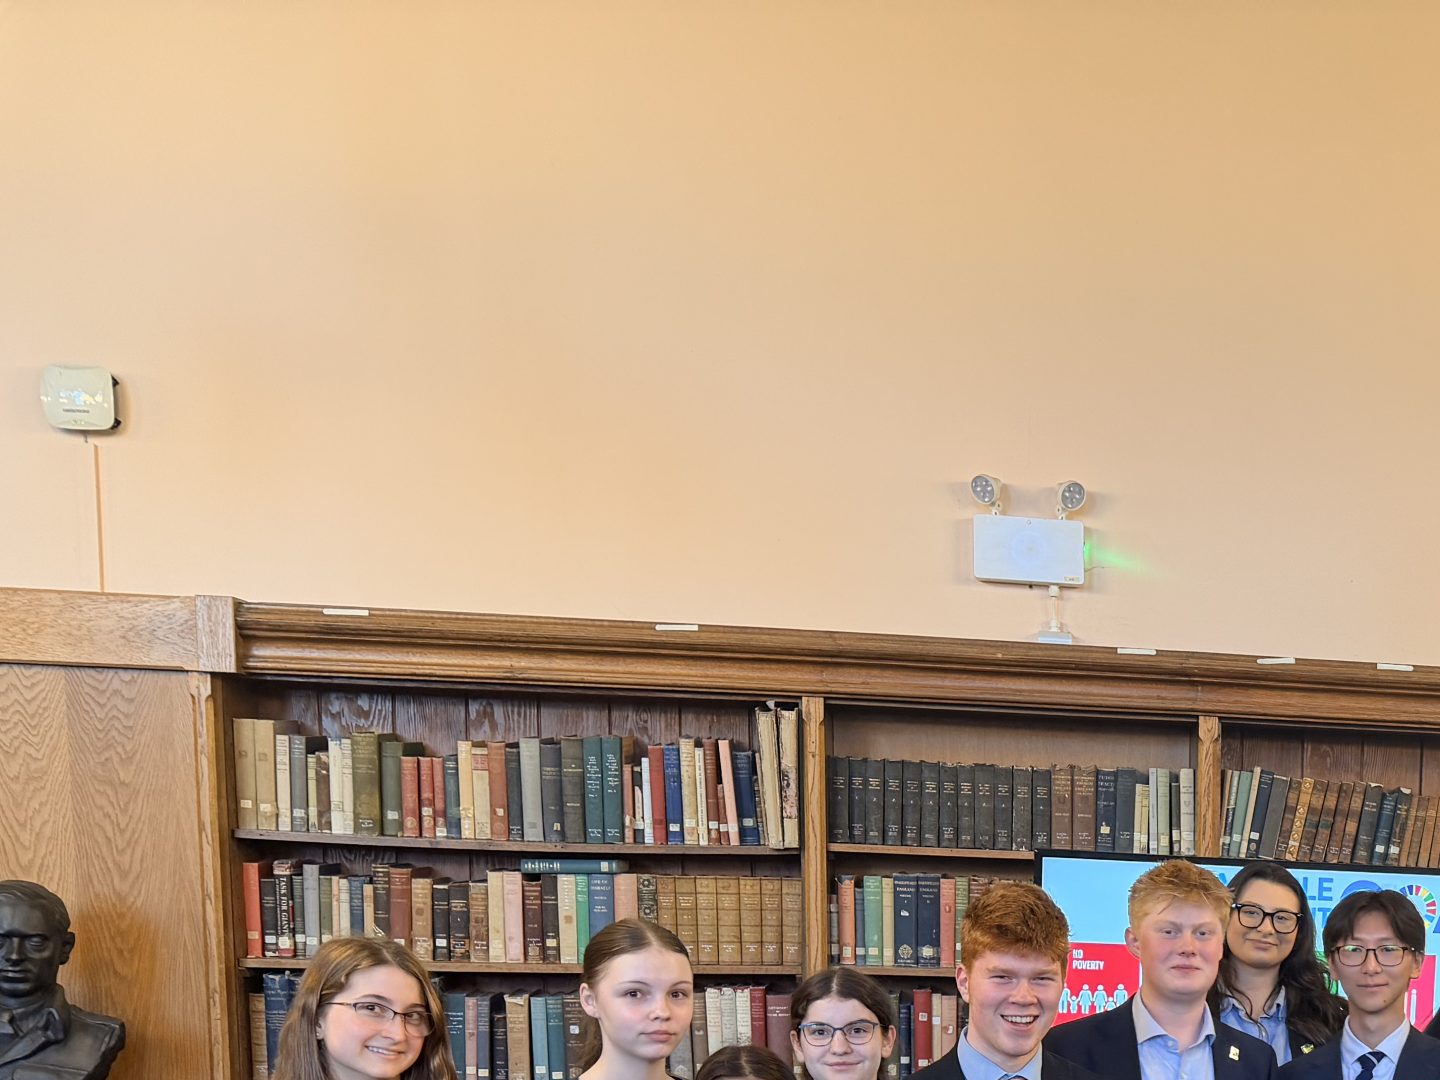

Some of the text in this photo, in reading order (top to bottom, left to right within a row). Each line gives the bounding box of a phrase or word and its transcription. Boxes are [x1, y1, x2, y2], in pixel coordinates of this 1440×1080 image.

[280, 877, 288, 894] TASK
[280, 897, 288, 910] FOR
[1072, 960, 1104, 970] POVERTY
